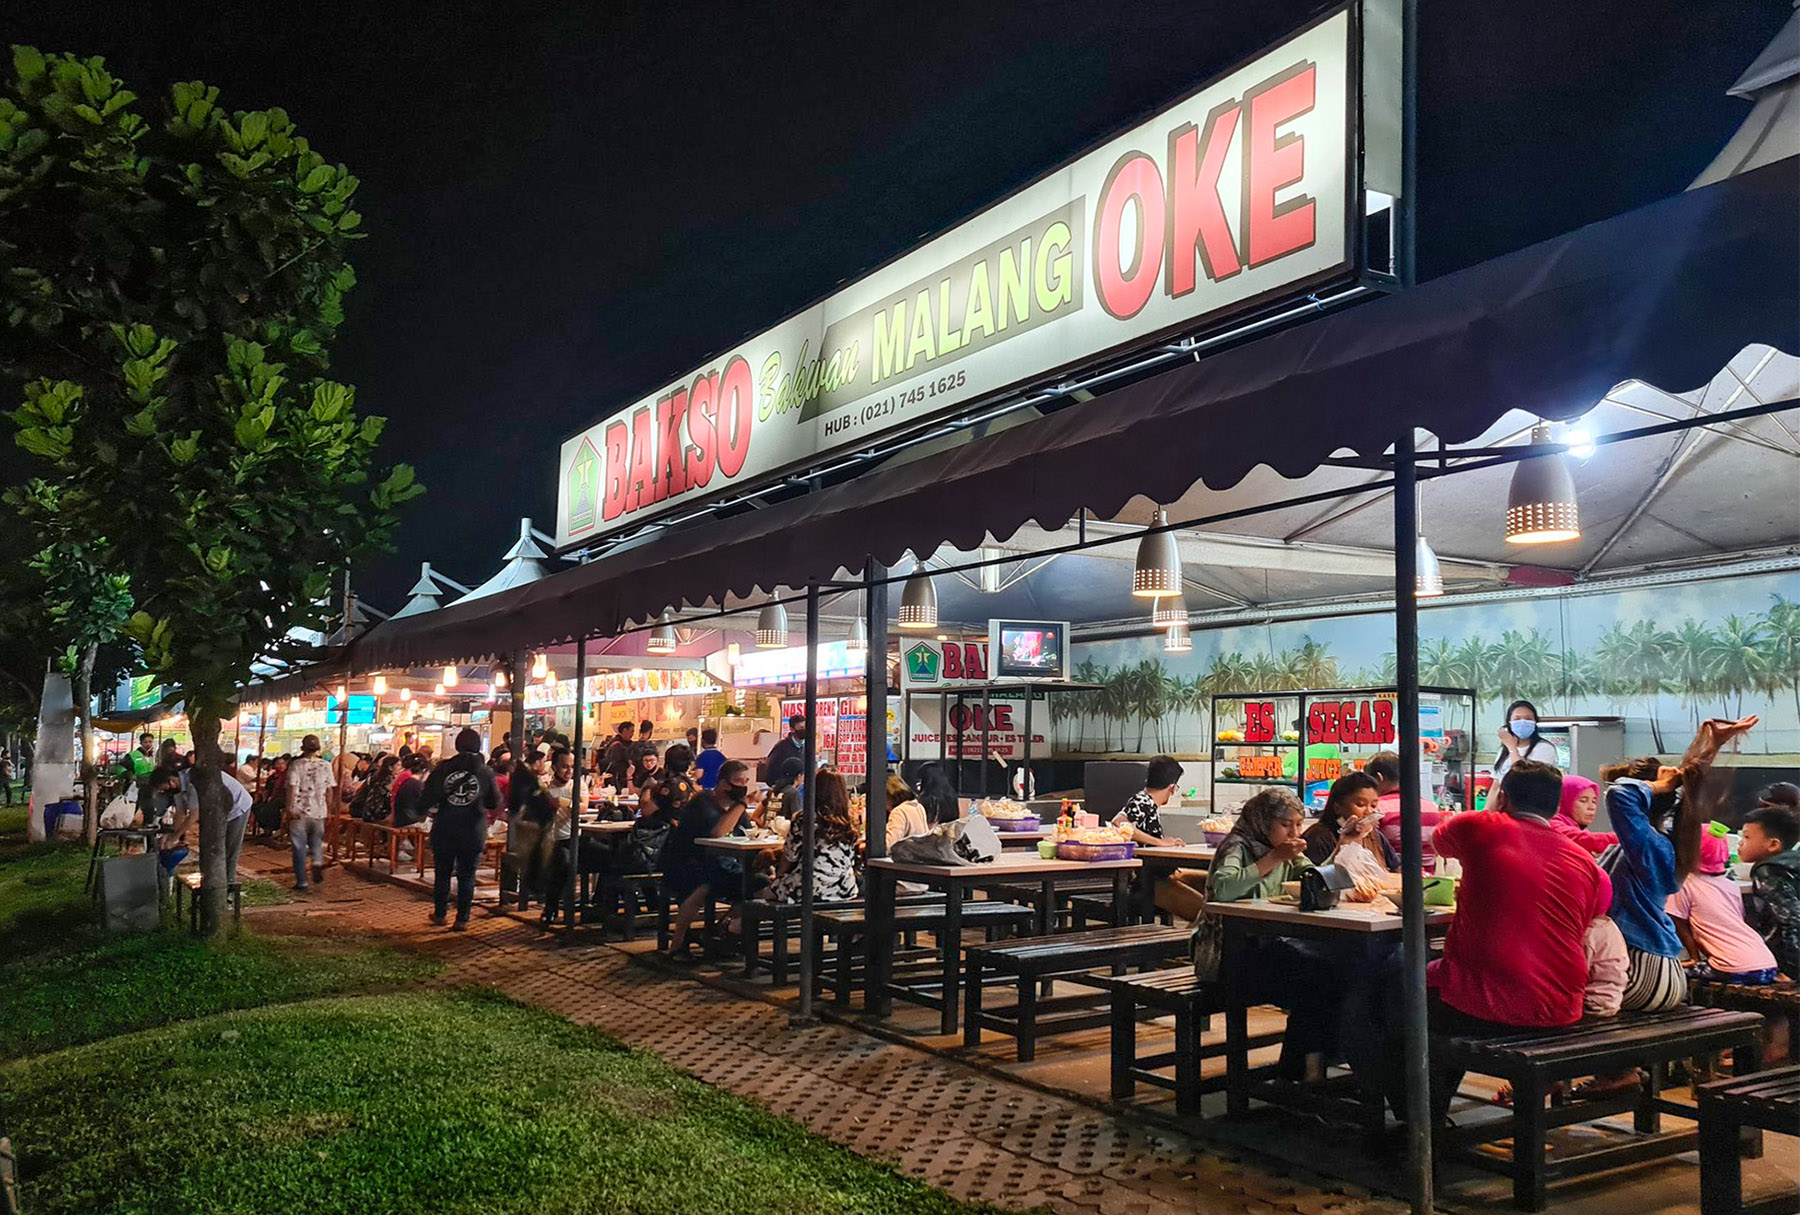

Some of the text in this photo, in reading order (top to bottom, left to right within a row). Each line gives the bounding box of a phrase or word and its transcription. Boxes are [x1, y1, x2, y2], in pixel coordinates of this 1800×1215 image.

[602, 59, 1316, 522] BAKSO Bakwan MALANG OKE
[861, 396, 895, 425] (021)
[900, 386, 925, 408] 745
[929, 370, 966, 398] 1625
[942, 643, 989, 679] BA
[949, 703, 1014, 731] OKE
[1244, 702, 1275, 742] ES
[1308, 701, 1395, 744] SEGAR
[912, 734, 940, 743] JUICE
[1306, 758, 1342, 780] JUICE
